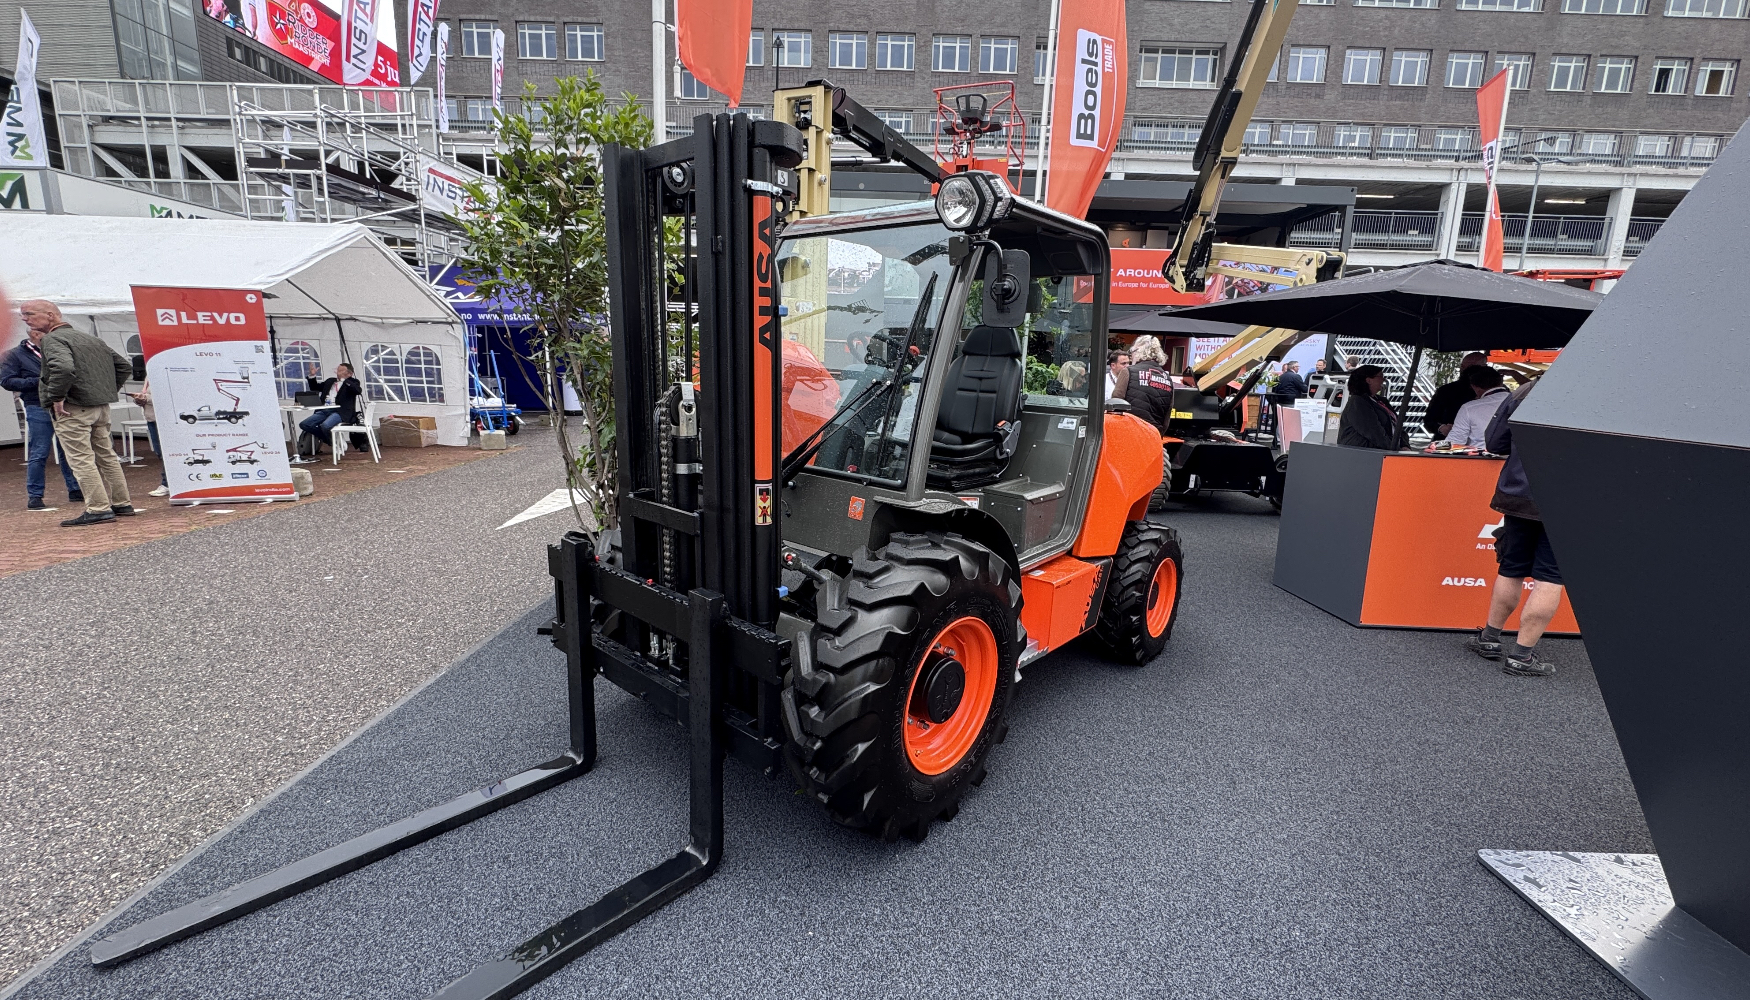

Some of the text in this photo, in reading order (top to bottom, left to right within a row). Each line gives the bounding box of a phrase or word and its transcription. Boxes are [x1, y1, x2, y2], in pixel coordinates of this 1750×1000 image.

[287, 12, 327, 47] RIDDER
[413, 0, 433, 72] INSTA
[288, 35, 330, 67] MAASTRICHT
[294, 31, 329, 60] RONDE
[1104, 43, 1113, 73] TRADE
[1076, 38, 1099, 141] Boels
[757, 215, 772, 352] AUSA
[1116, 268, 1164, 278] AROUN
[180, 311, 246, 325] LEVO
[188, 473, 203, 481] CE
[1441, 576, 1487, 587] AUSA
